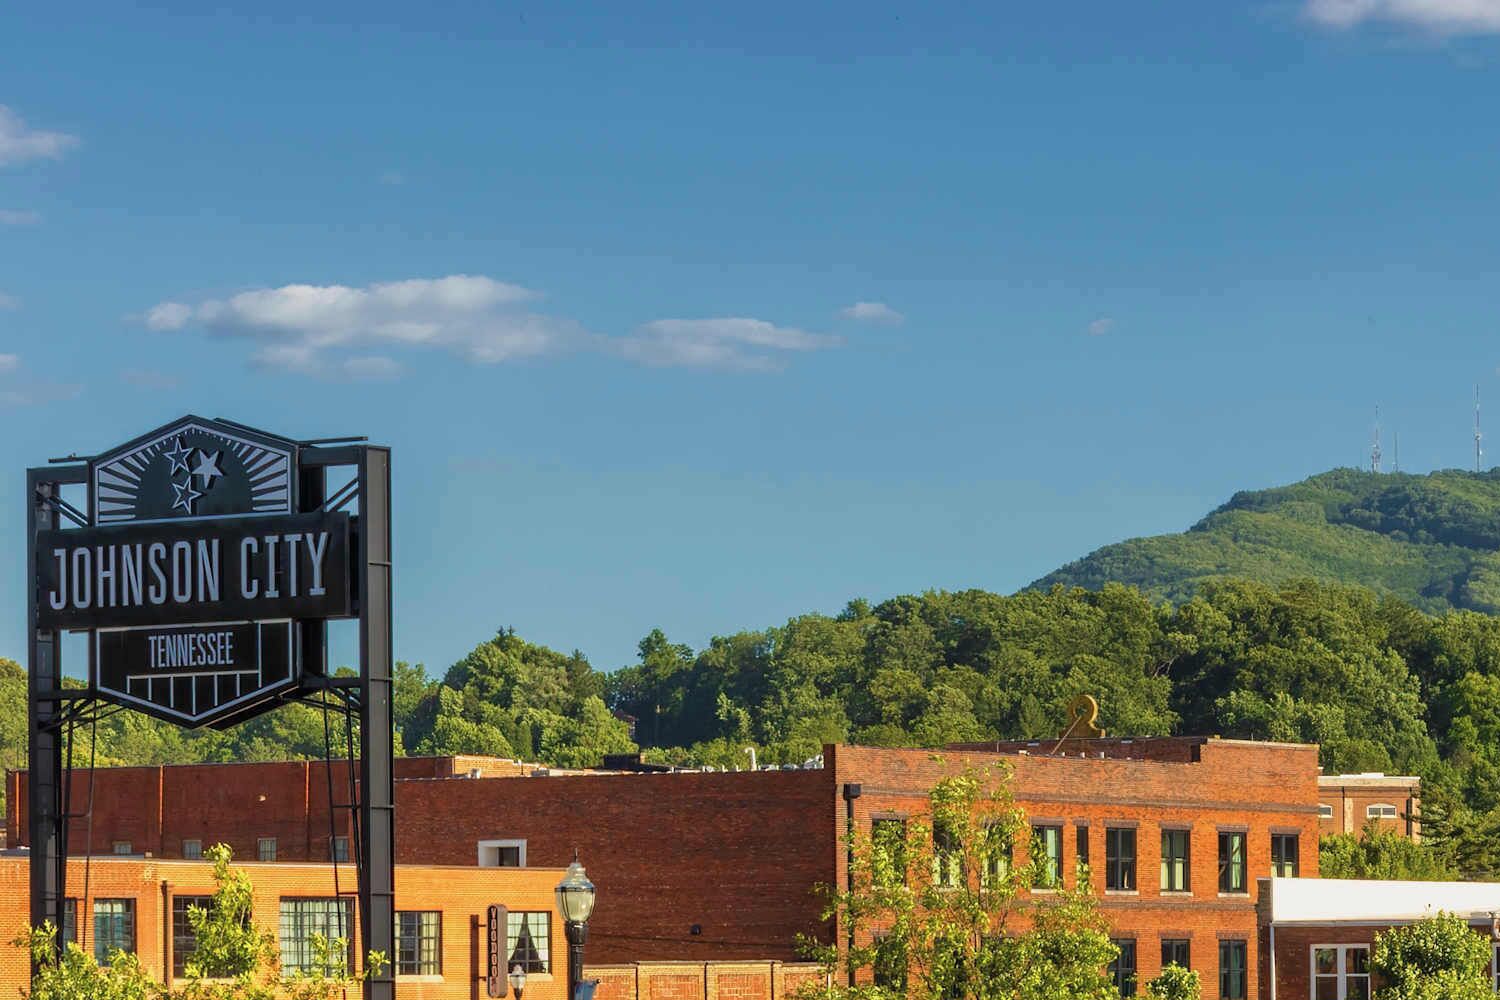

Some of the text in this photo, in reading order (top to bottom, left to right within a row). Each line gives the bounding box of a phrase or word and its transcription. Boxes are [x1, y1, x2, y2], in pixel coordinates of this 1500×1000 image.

[50, 531, 329, 610] JOHNSON CITY
[148, 632, 234, 668] TENNESSEE
